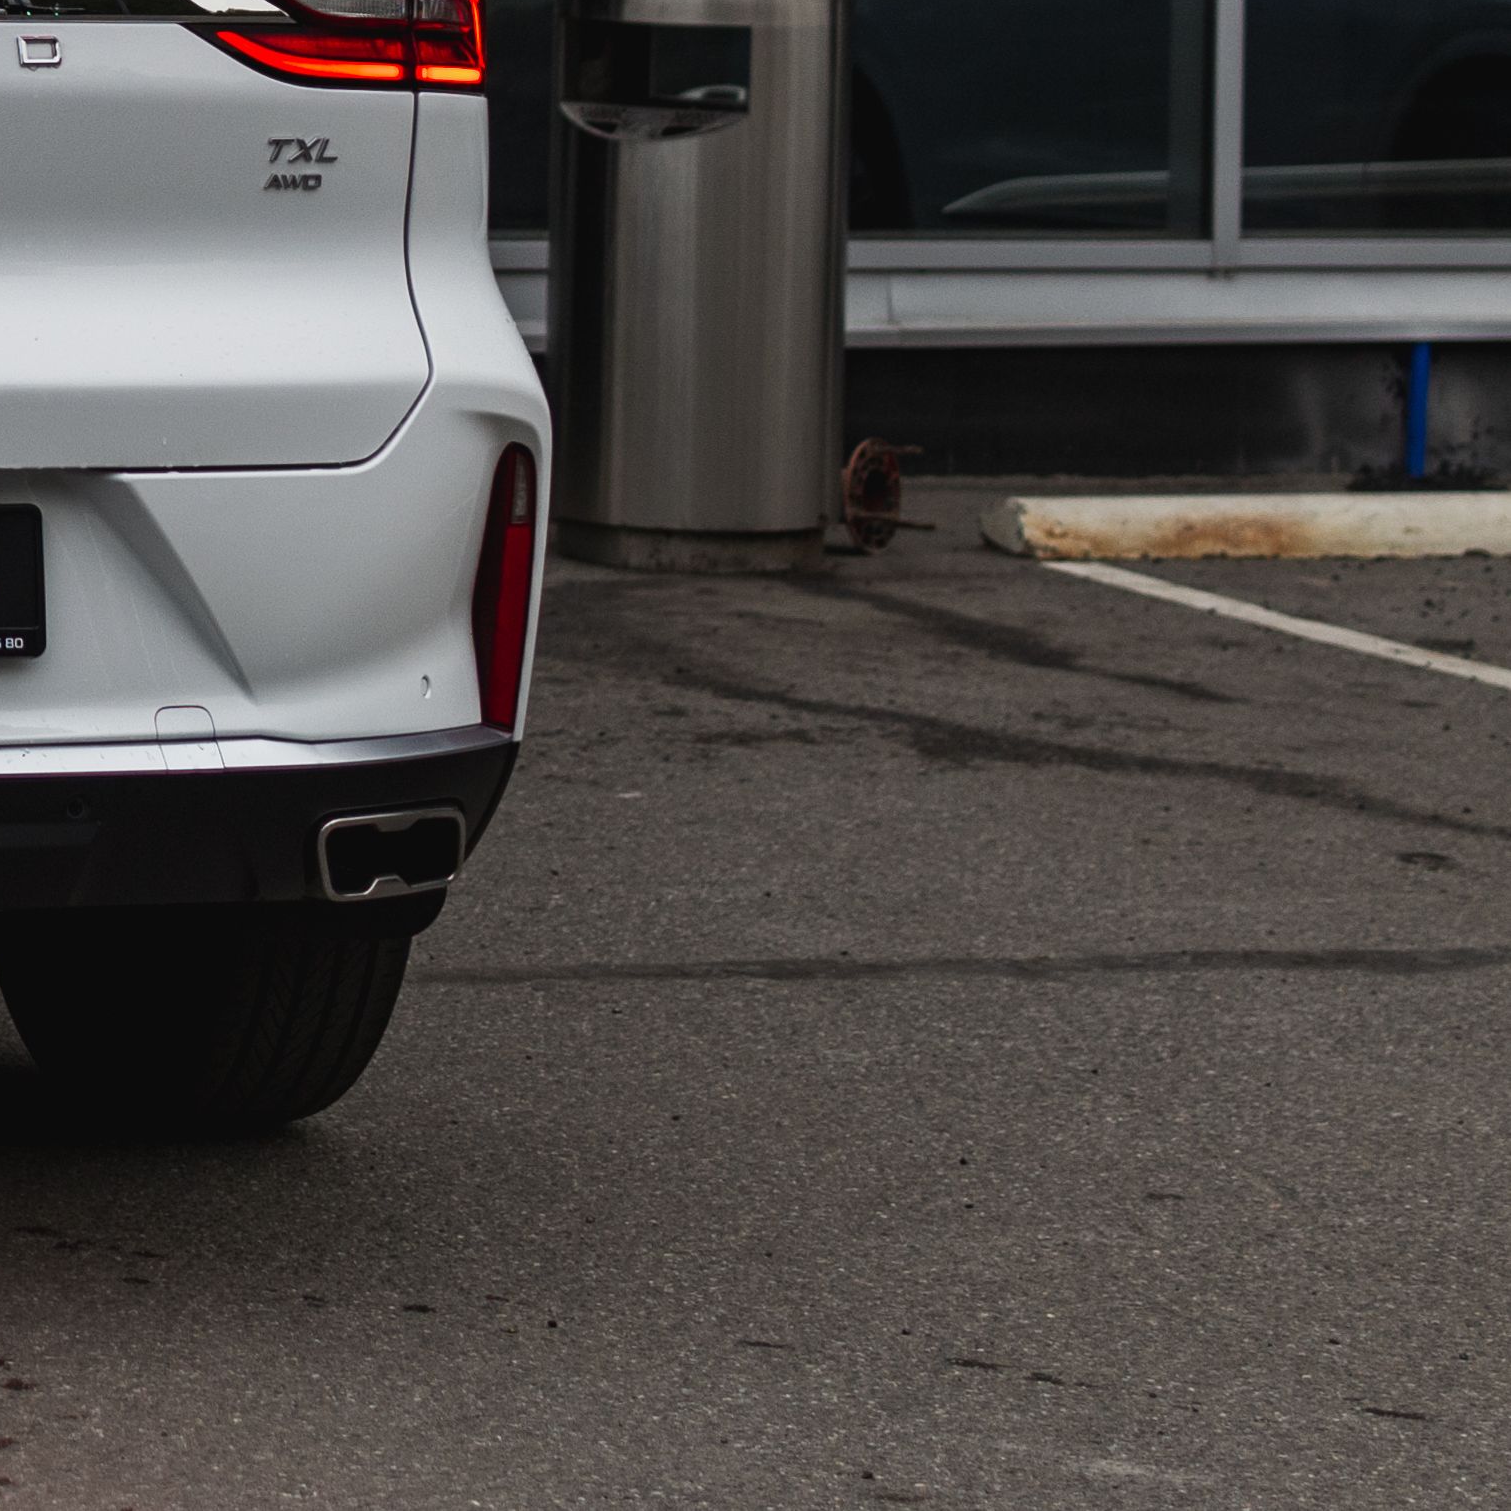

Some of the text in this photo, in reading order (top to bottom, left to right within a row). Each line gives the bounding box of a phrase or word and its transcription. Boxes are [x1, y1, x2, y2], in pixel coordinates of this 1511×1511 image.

[268, 137, 338, 163] TXL
[263, 173, 322, 191] AWD
[5, 637, 24, 649] 80
